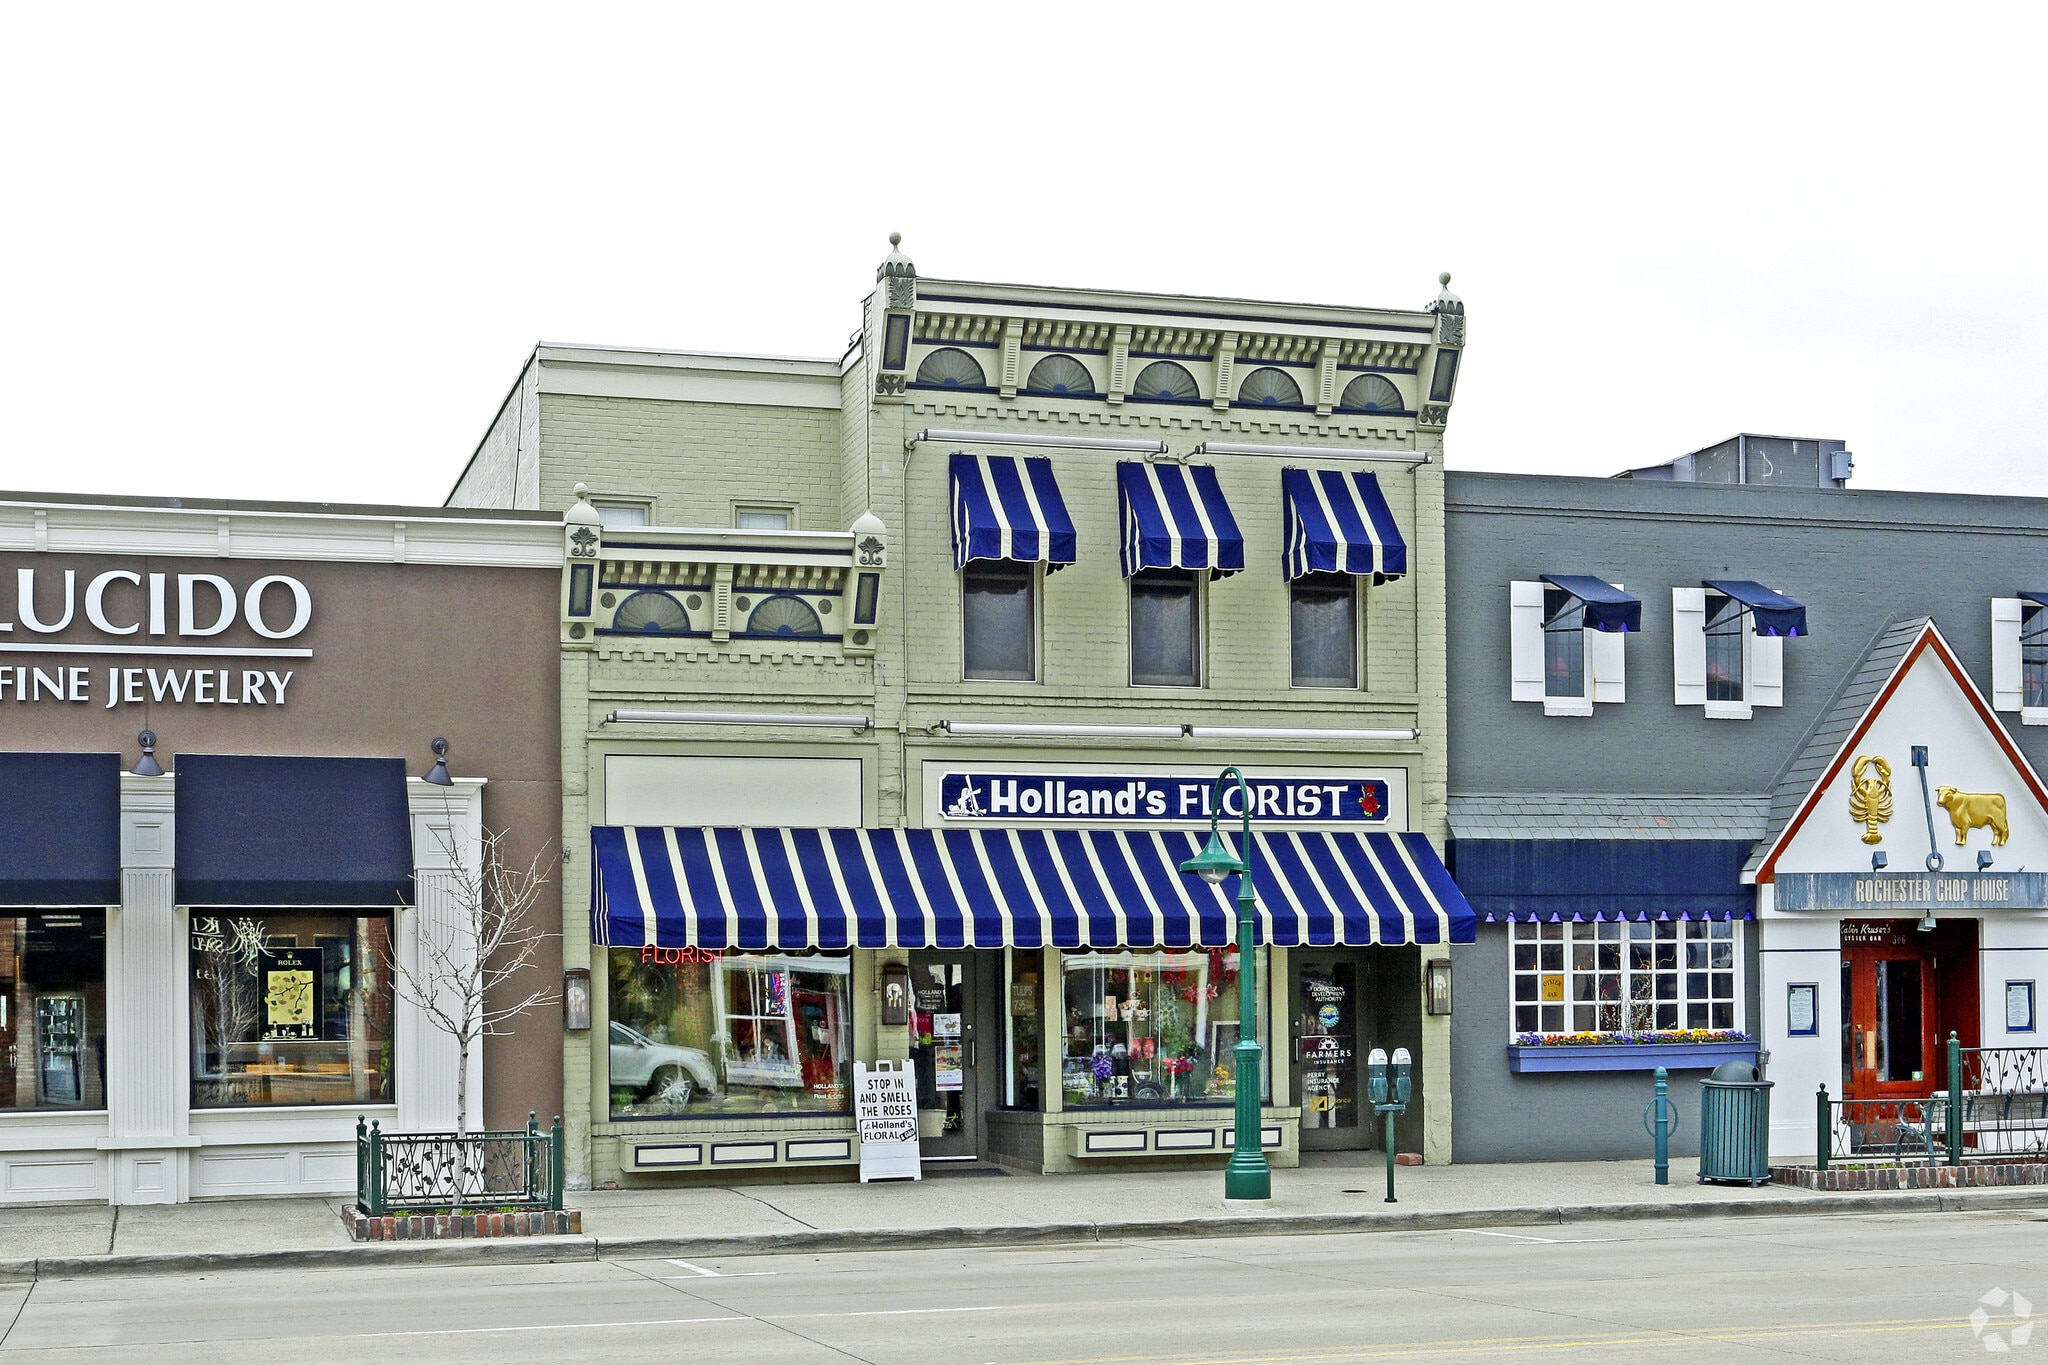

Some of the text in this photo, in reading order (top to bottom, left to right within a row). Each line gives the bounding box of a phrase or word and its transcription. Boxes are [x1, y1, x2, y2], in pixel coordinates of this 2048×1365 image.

[0, 568, 313, 639] UCIDO
[105, 667, 294, 709] JEWELRY
[990, 779, 1349, 817] Holland's FLORIST
[1855, 879, 2009, 903] ROCHESTER CHOP HOUSE
[1306, 1049, 1352, 1059] FARMERS
[867, 1079, 904, 1090] STOP IN
[860, 1092, 912, 1103] AND SMELL
[862, 1105, 912, 1117] THE ROSES
[872, 1120, 912, 1129] Holland's
[864, 1131, 899, 1140] FLORAL
